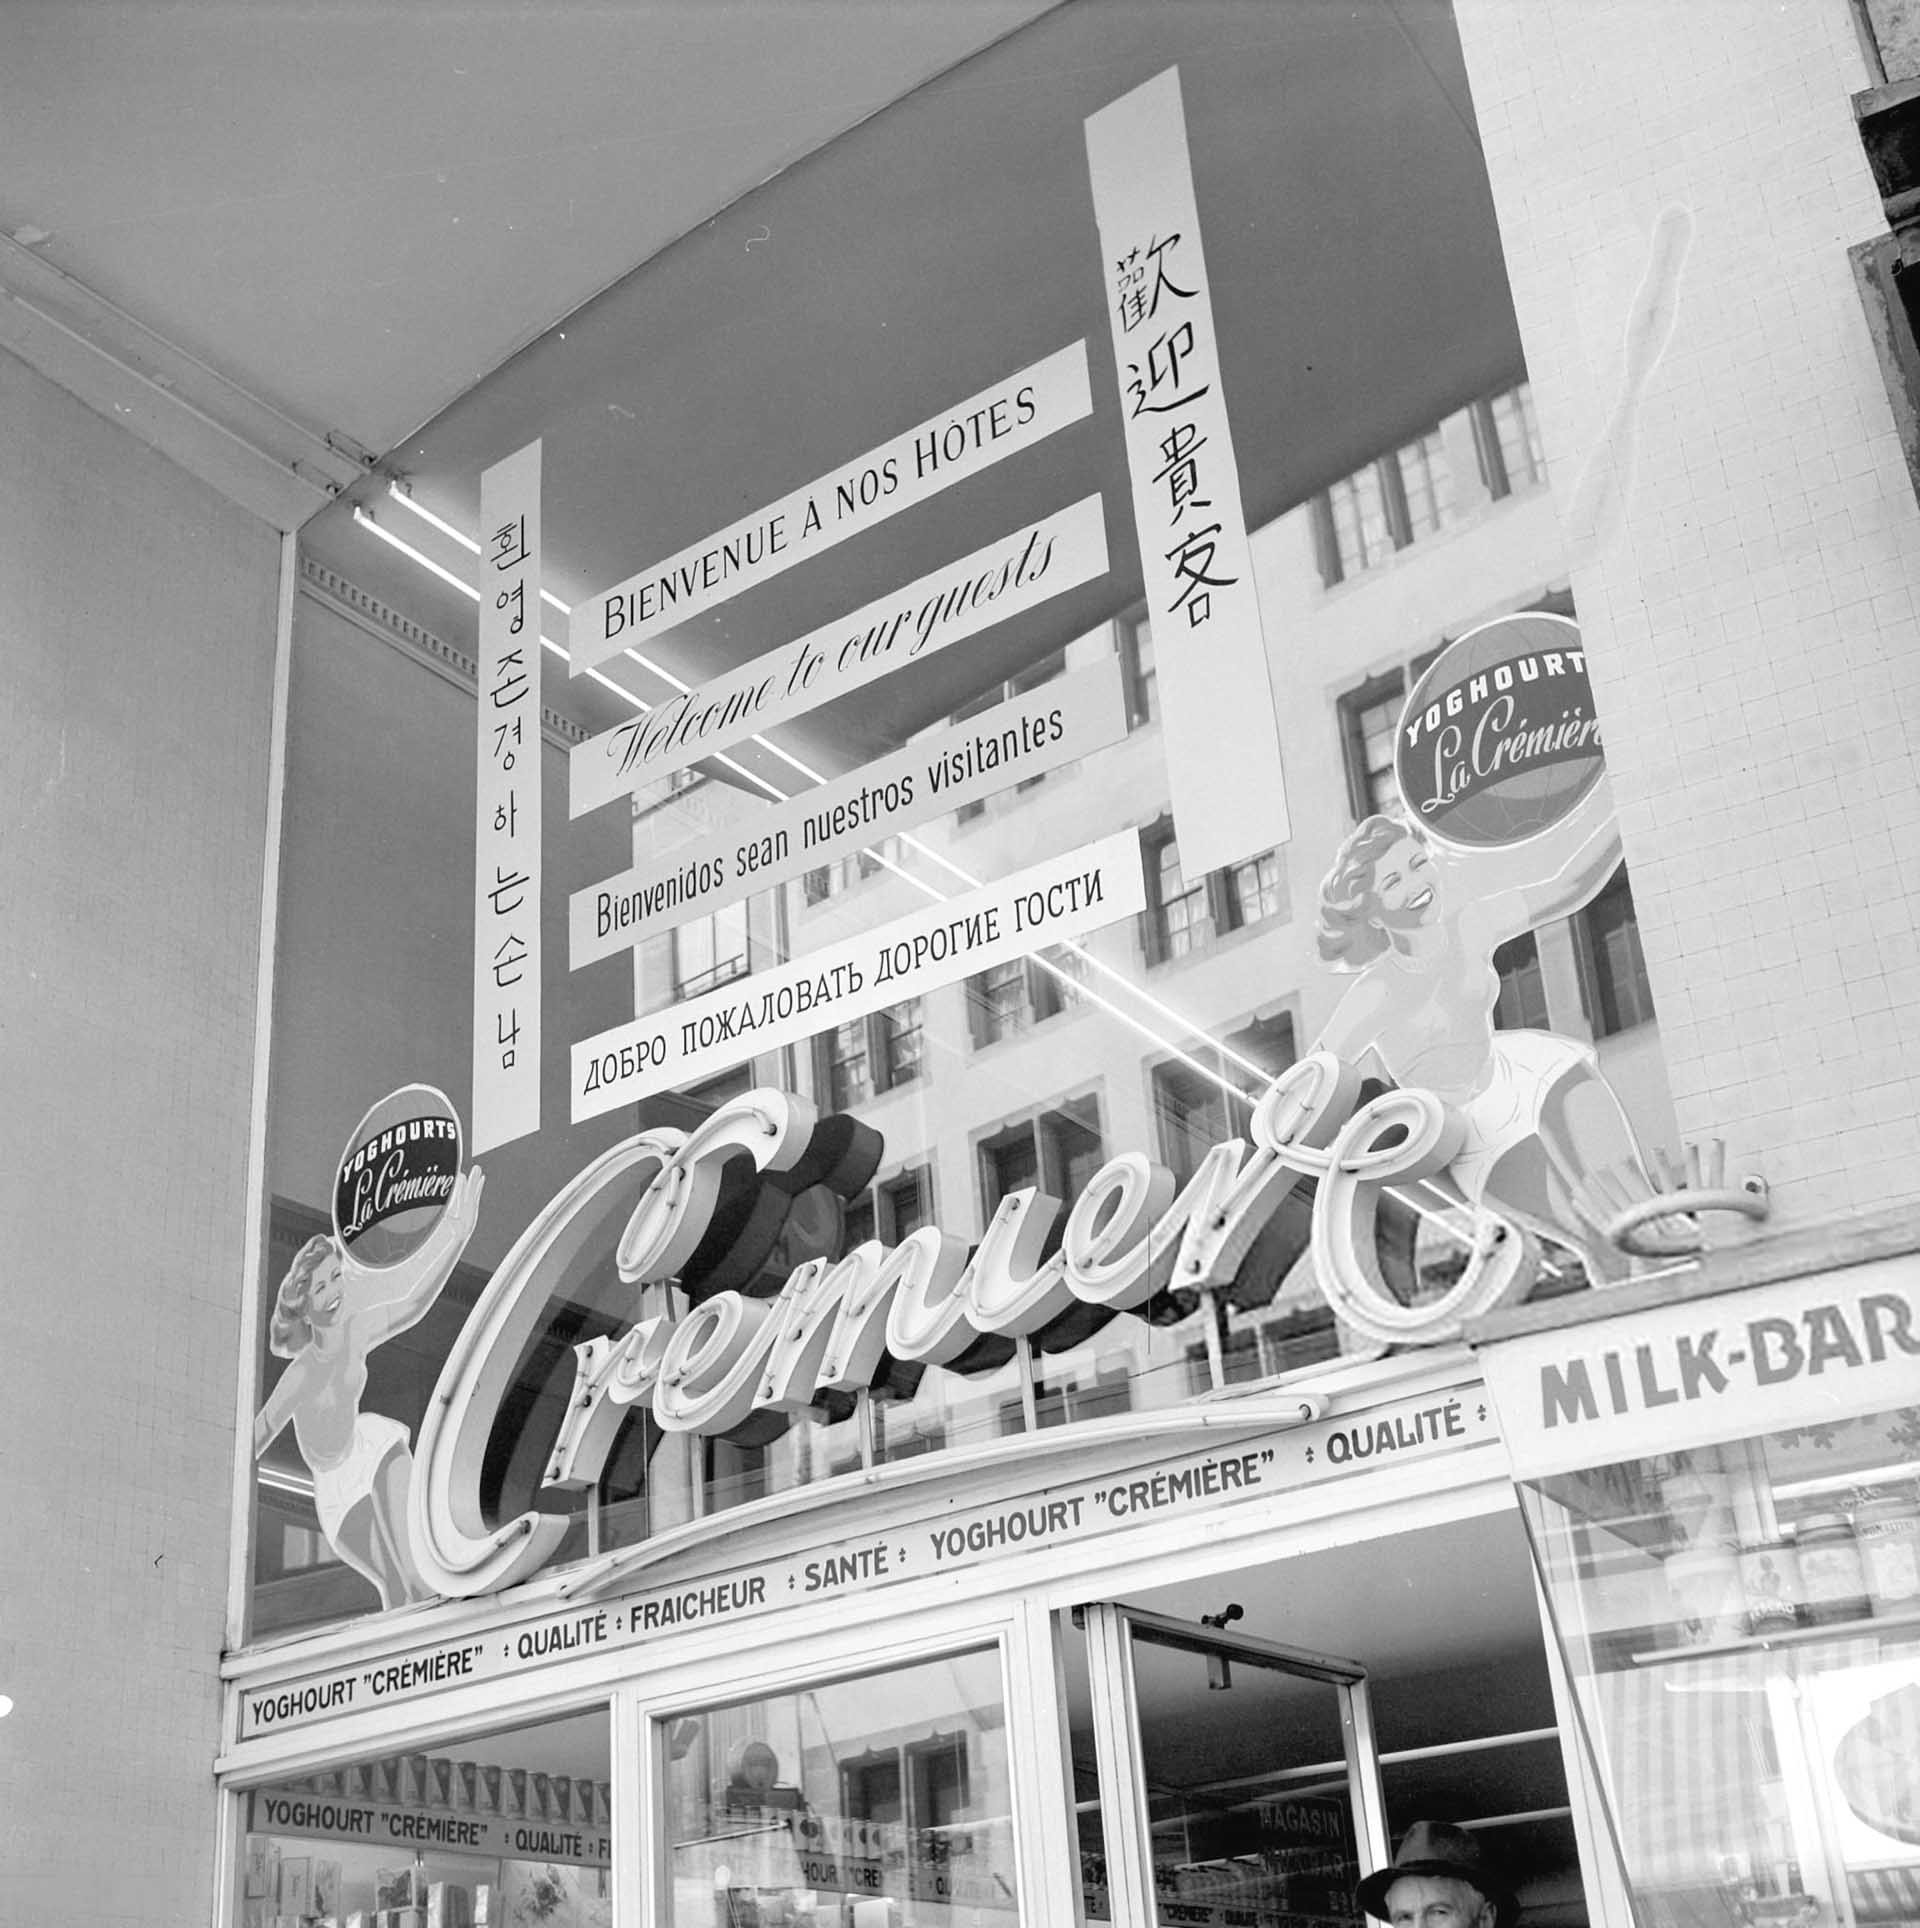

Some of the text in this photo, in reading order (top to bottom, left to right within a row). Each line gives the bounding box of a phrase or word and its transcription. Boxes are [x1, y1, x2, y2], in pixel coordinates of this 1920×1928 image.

[1116, 232, 1240, 629] 歡迎貴客
[604, 515, 788, 640] BIENVENUE
[836, 457, 899, 520] NOS
[606, 529, 1058, 777] Welcome to our guests
[596, 706, 1064, 939] Bienvenidos sean nuestros visitantes
[1420, 724, 1472, 814] La
[583, 868, 1104, 1096] ДОБРО ПОЖАЛОВАТЬ ДОРОГИЕ ГОСТИ
[343, 1120, 456, 1183] YOGHOURTS
[343, 1168, 374, 1237] La
[1540, 1293, 1920, 1429] MILK-BAR
[252, 1677, 357, 1725] YOGHOURT
[517, 1609, 607, 1660] QUALITÉ
[630, 1576, 766, 1633] FRAICHEUR
[804, 1541, 889, 1592] SANTÉ
[930, 1496, 1085, 1561] YOGHOURT
[1326, 1398, 1466, 1464] QUALITÉ
[264, 1799, 375, 1834] YOGHOURT
[515, 1829, 582, 1857] QUALITÉ
